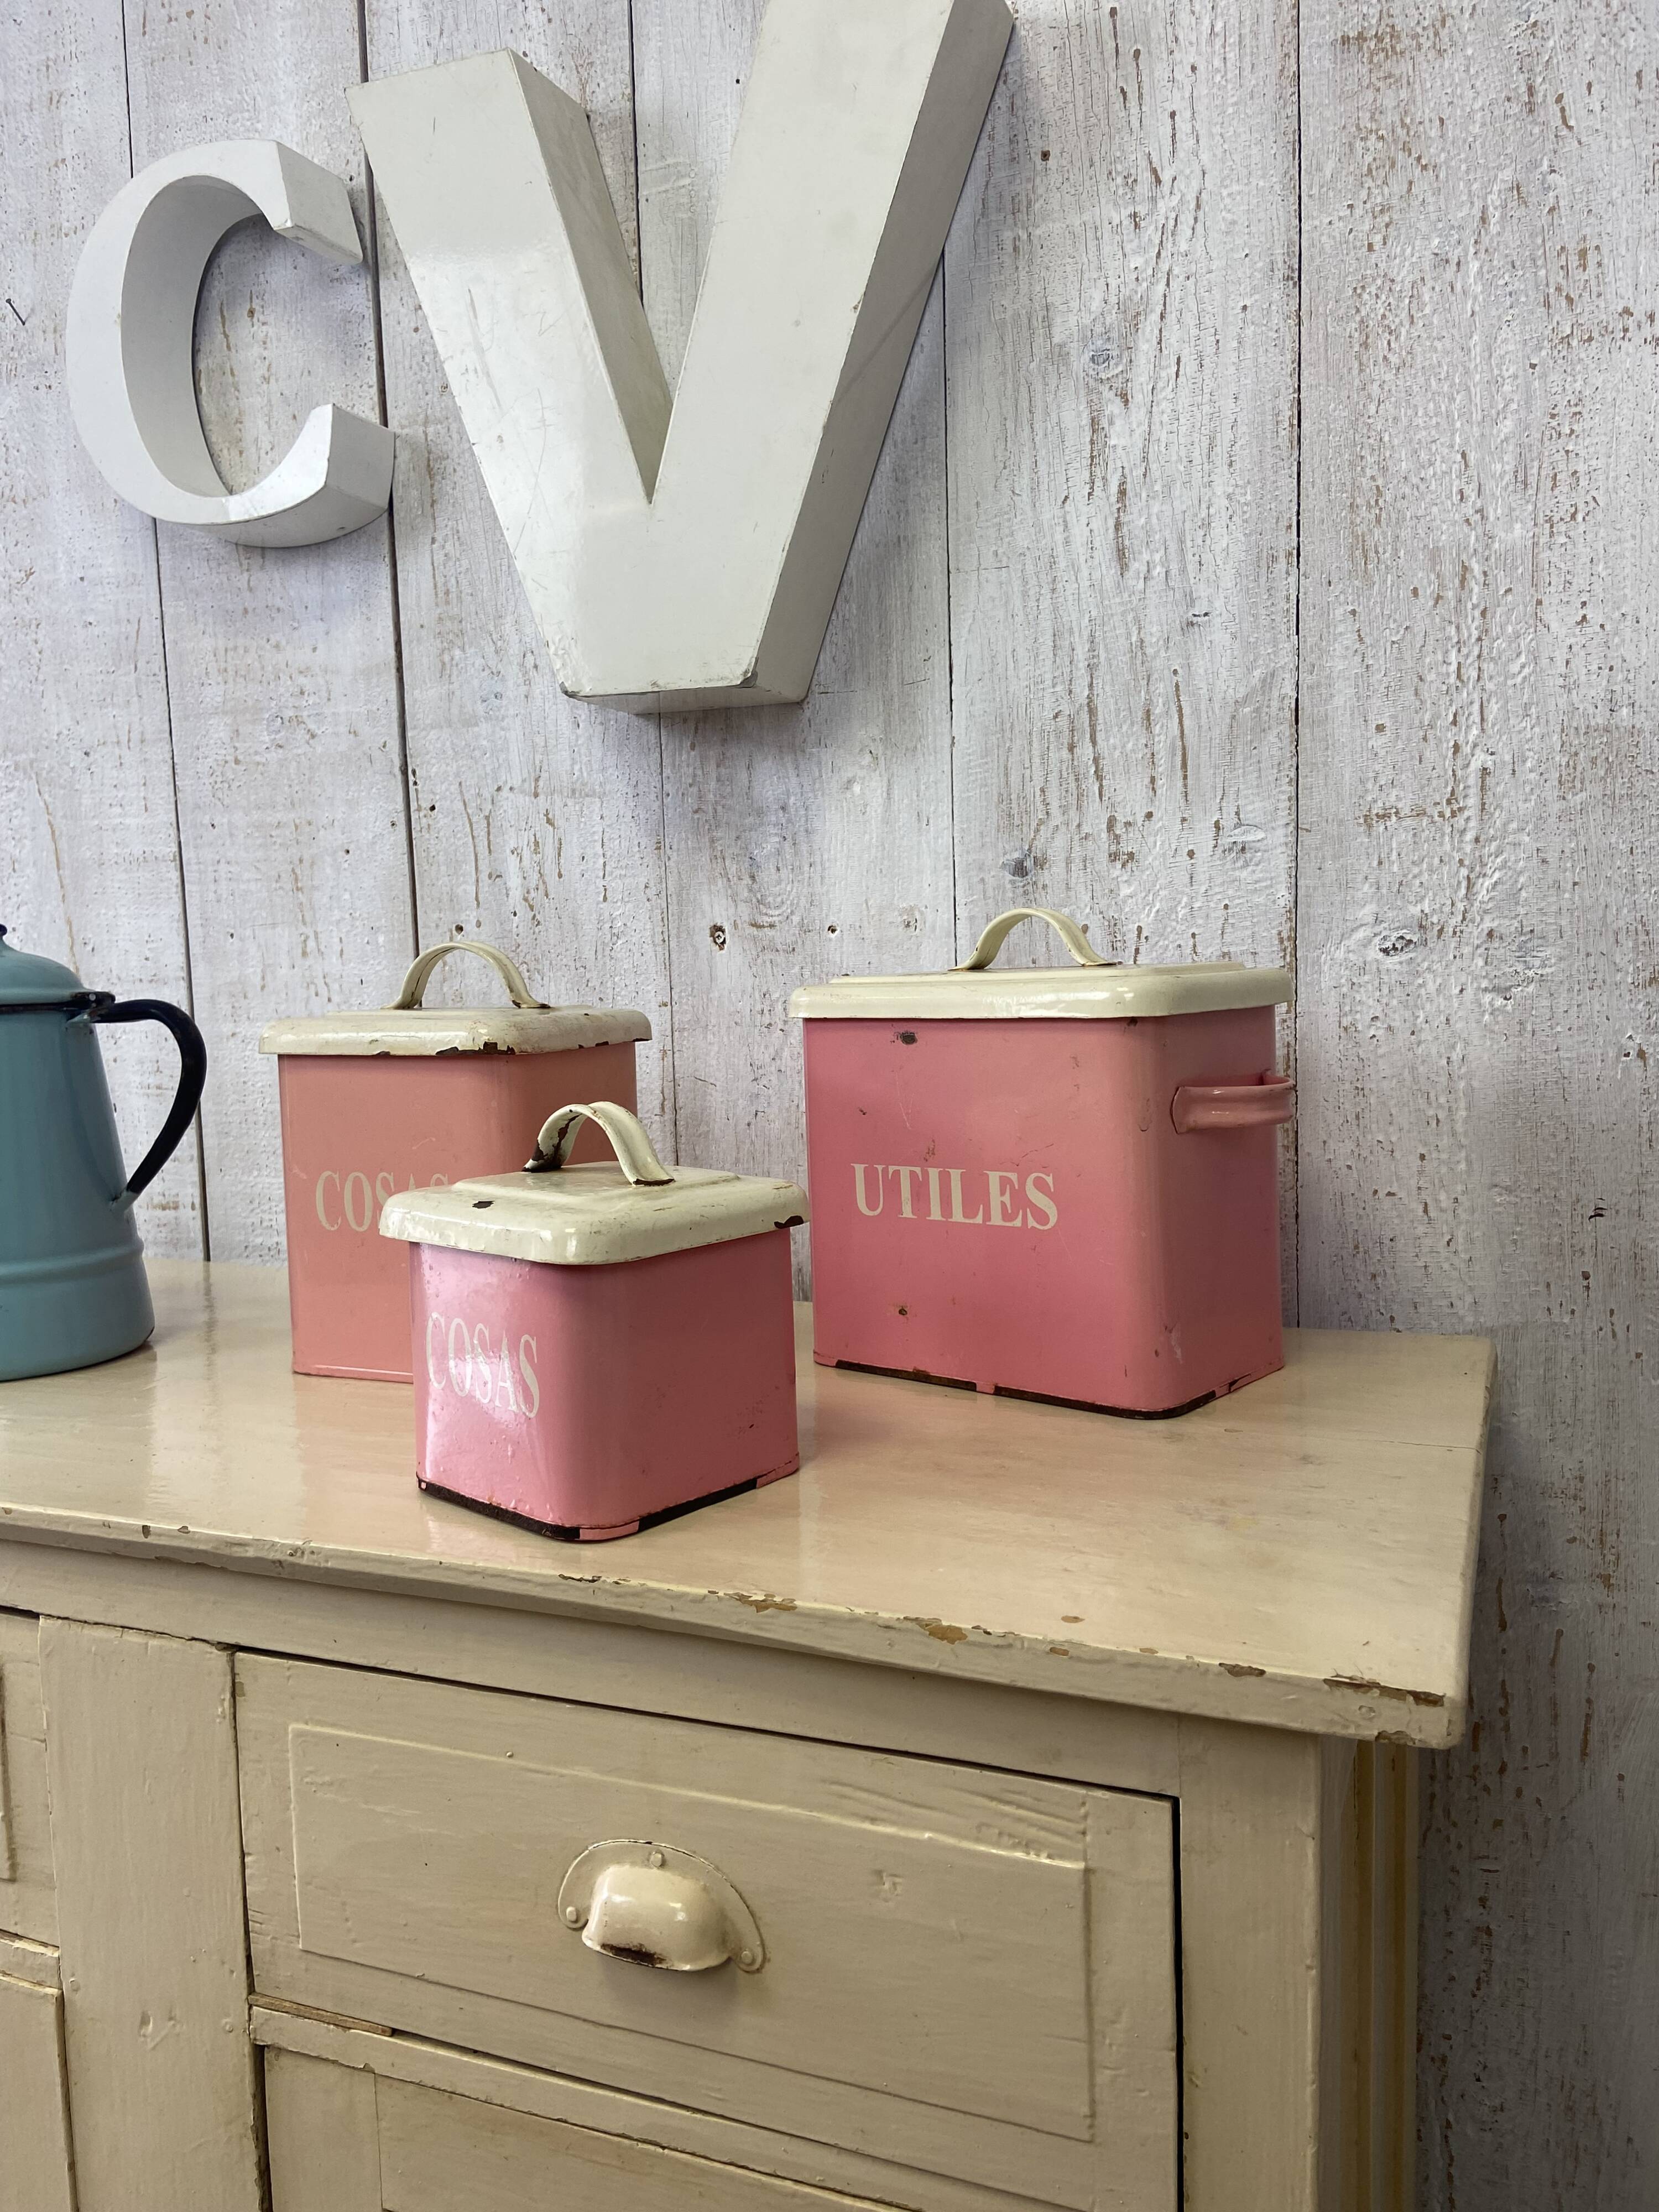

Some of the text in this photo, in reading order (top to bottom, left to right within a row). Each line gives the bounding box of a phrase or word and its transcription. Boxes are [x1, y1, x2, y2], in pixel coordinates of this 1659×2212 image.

[315, 1170, 449, 1232] COS
[851, 1163, 1058, 1230] UTILES
[426, 1311, 540, 1418] COSAS
